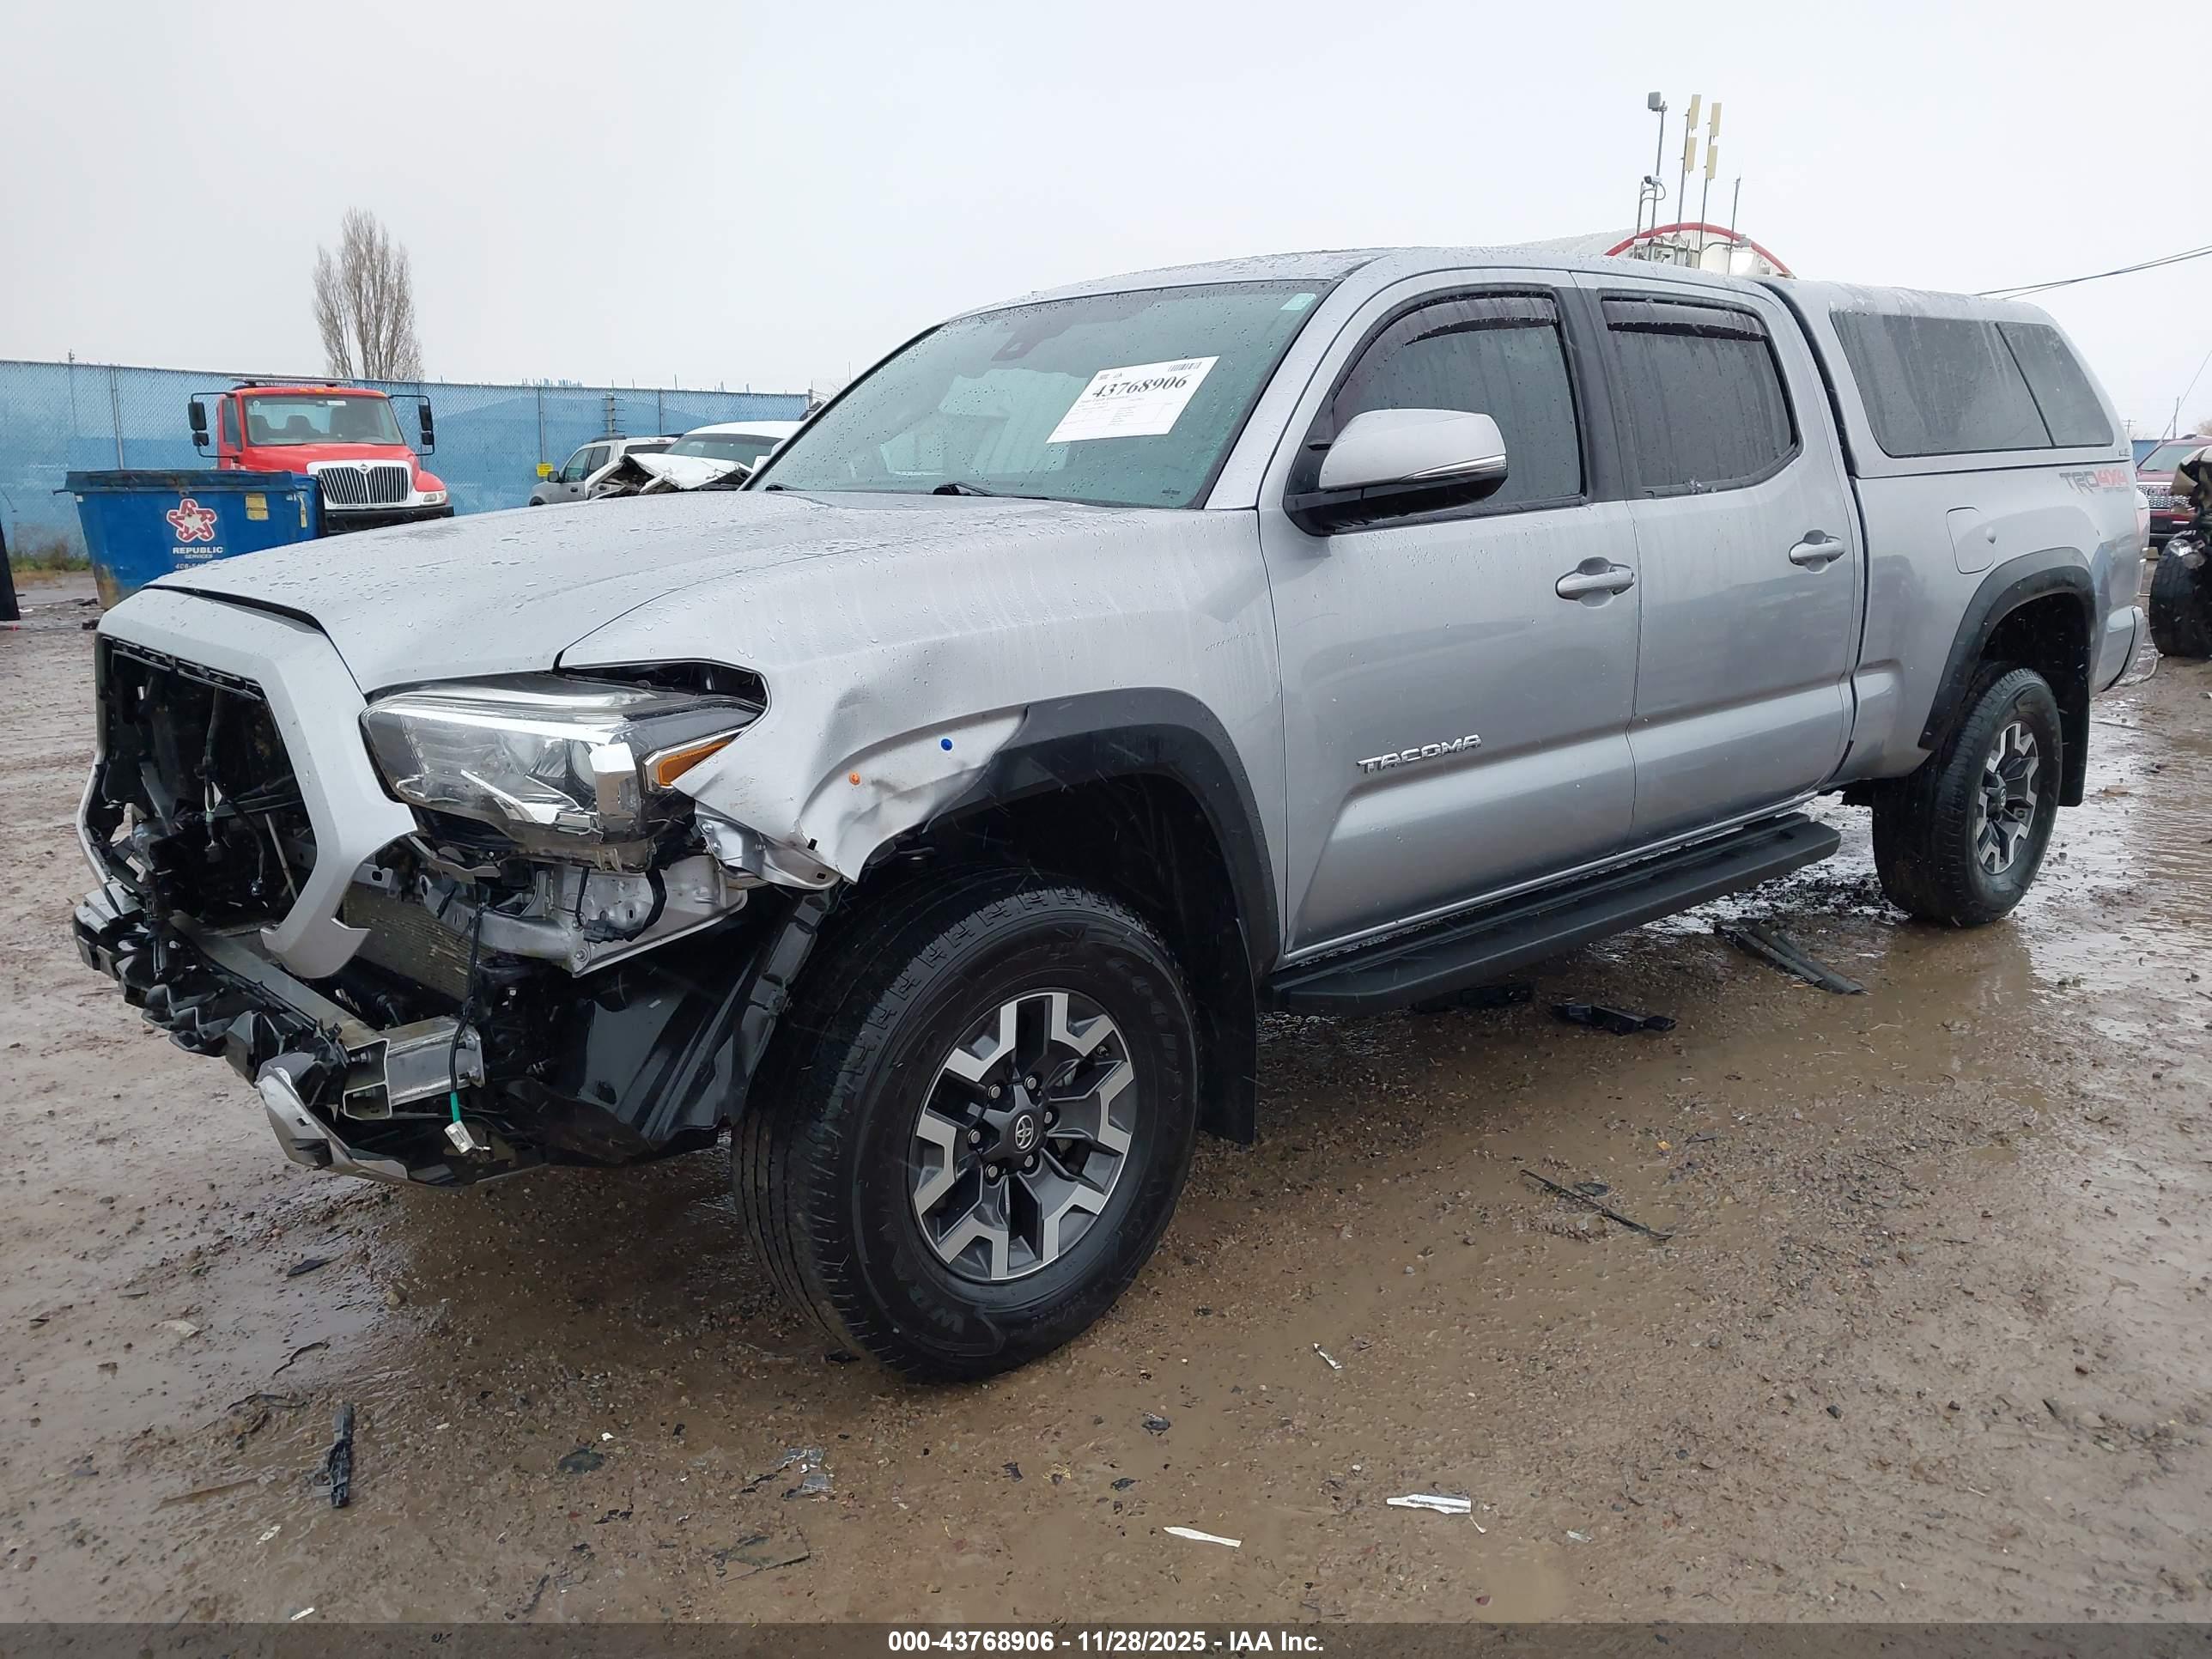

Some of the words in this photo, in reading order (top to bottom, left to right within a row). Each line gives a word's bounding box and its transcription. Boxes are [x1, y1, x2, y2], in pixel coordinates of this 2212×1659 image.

[1092, 374, 1192, 398] 43768906
[173, 546, 223, 555] REPUBLIC
[1356, 733, 1482, 773] TACOMA
